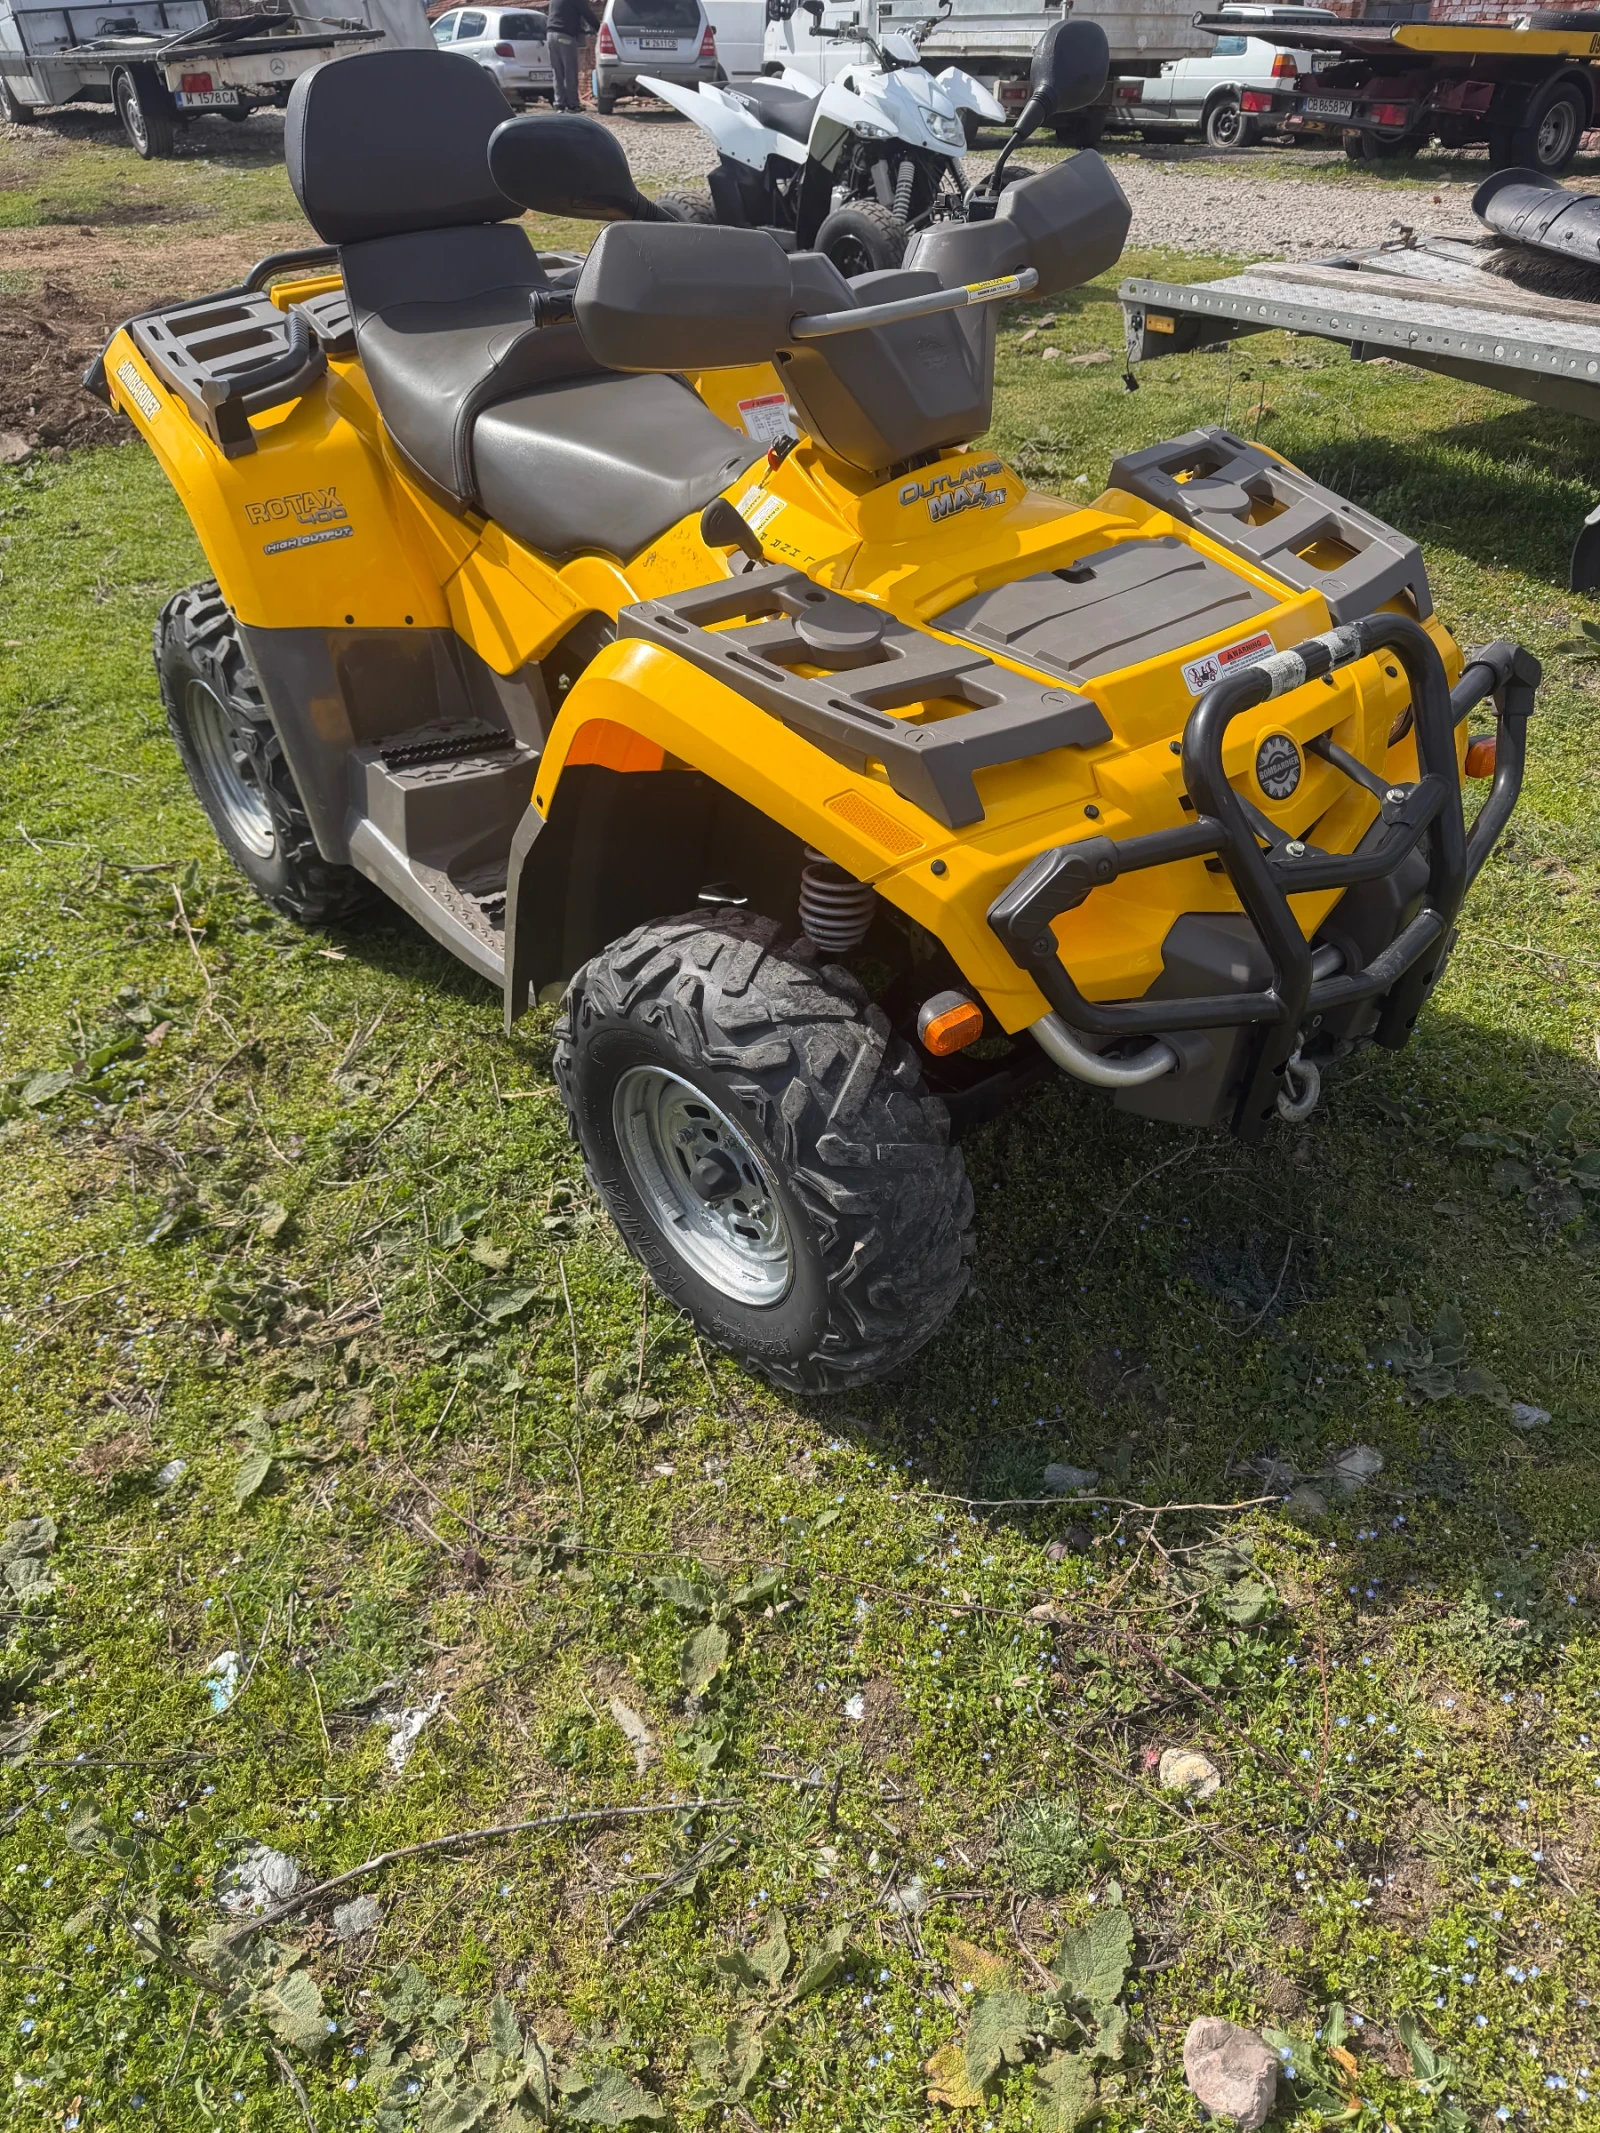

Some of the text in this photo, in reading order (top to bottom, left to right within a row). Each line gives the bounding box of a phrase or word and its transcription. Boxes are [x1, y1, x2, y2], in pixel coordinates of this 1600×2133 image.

[117, 360, 162, 422] BOMBARDIER
[244, 486, 343, 525] ROTAX
[927, 480, 1007, 522] MAX XT
[297, 507, 348, 525] 400
[267, 527, 351, 552] HIGH OUTPUT
[1232, 640, 1262, 661] WARNING
[1259, 755, 1299, 779] BOMBARDIER
